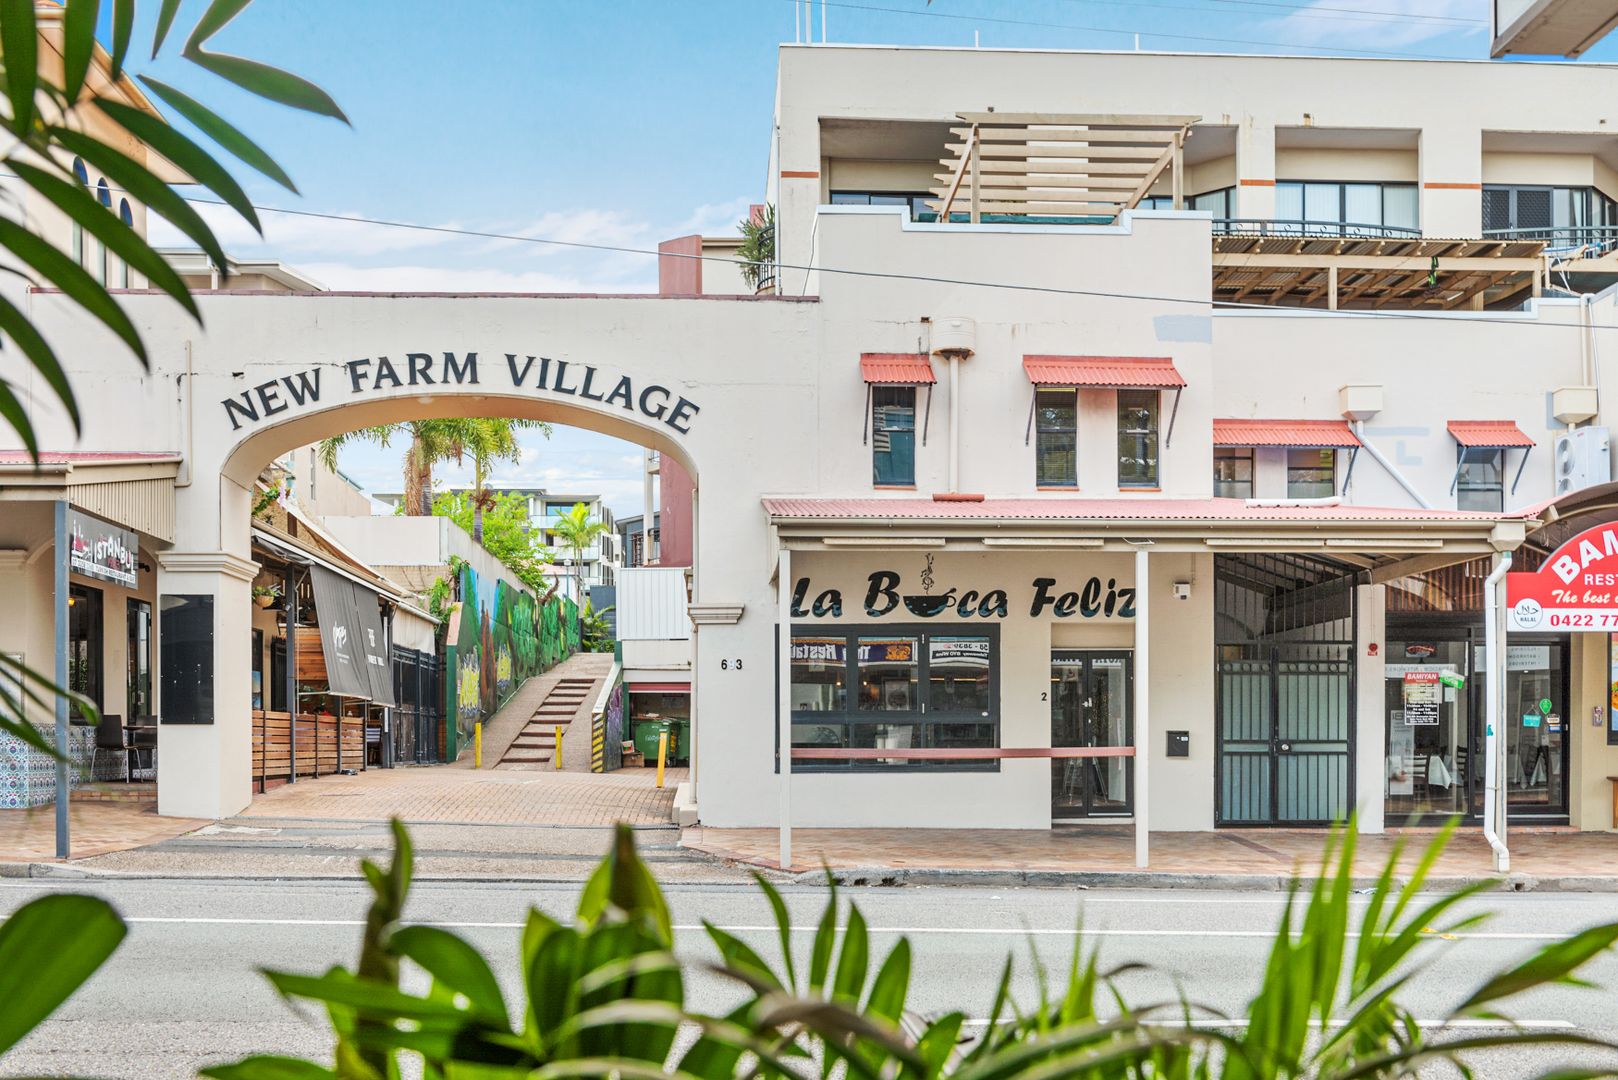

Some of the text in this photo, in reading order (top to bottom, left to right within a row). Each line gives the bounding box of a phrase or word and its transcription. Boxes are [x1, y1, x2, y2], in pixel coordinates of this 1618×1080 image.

[221, 351, 701, 435] NEW FARM VILLAGE
[94, 535, 136, 574] ISTANBUL
[1584, 573, 1618, 586] RES
[790, 577, 843, 618] La
[1029, 576, 1136, 618] Feliz
[1551, 589, 1578, 604] The
[1582, 589, 1611, 604] best
[1516, 605, 1539, 615] حلال
[1550, 614, 1618, 627] 0422 77
[720, 658, 743, 670] 693
[1040, 691, 1048, 702] 2
